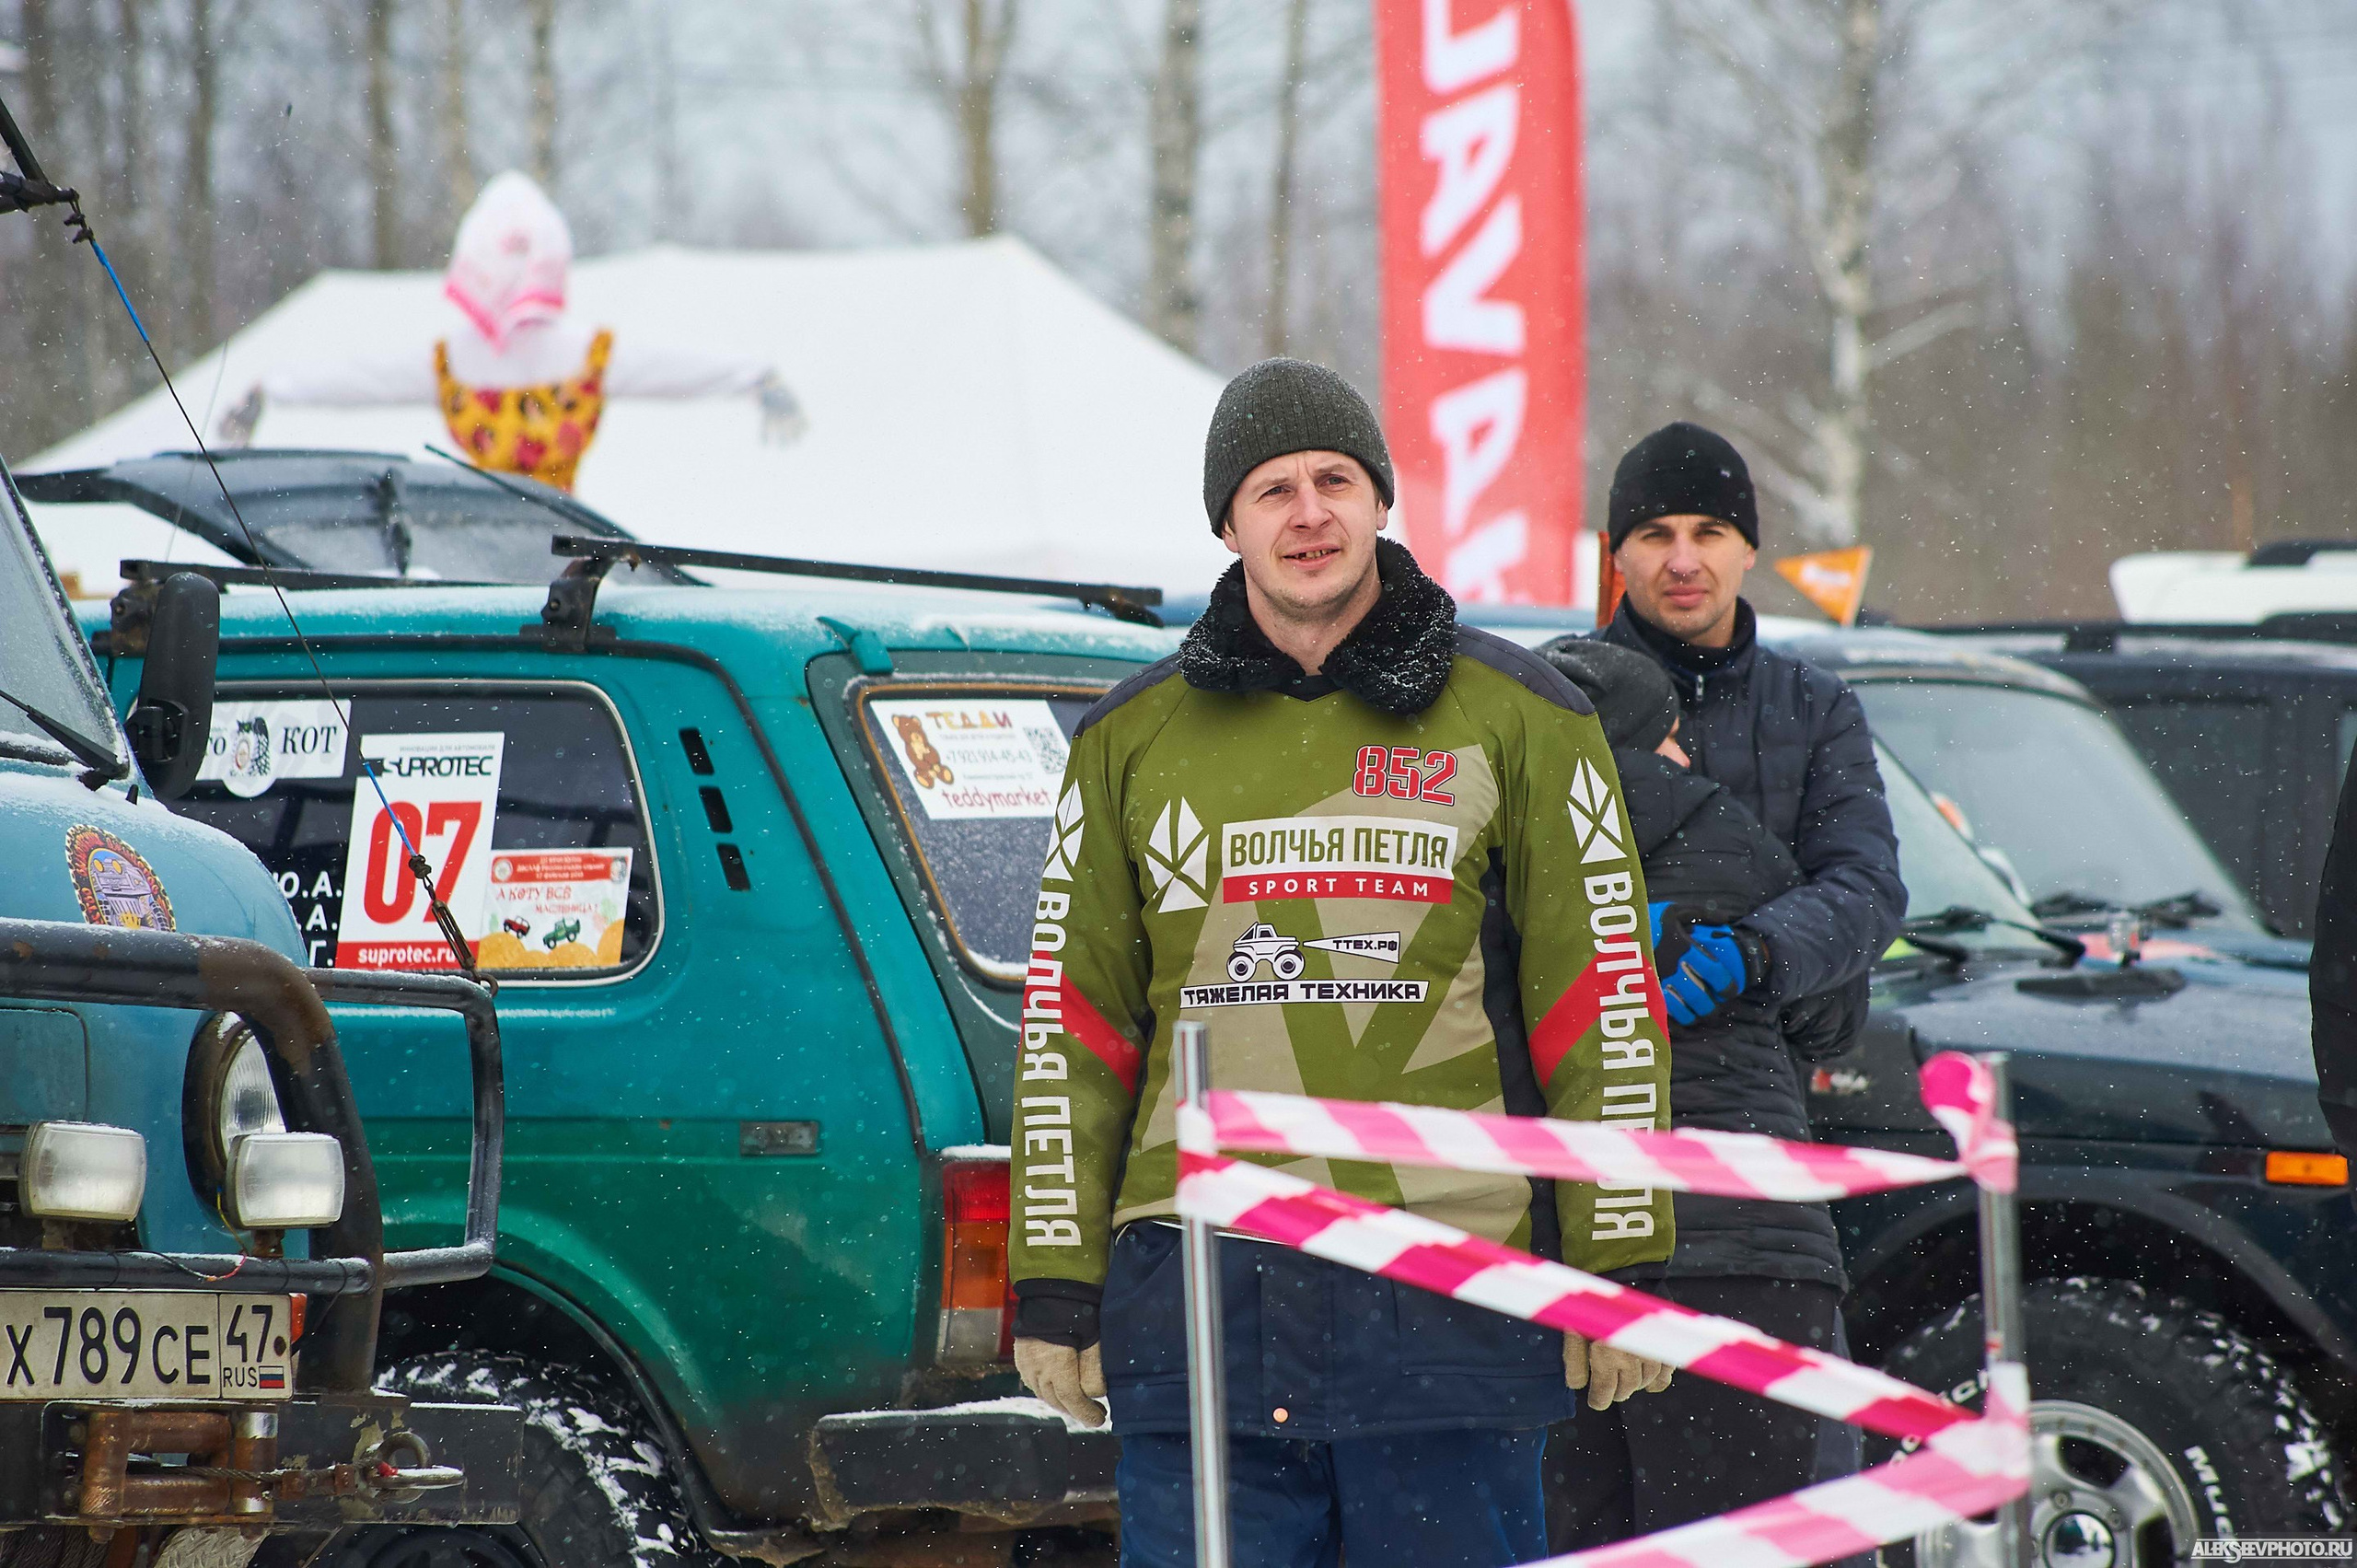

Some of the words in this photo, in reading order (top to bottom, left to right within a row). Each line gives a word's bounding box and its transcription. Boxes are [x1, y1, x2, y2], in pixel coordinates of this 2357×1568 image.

[282, 726, 337, 754] КОТ
[367, 755, 493, 777] SUPROTEC
[1353, 744, 1458, 807] 852
[941, 785, 1051, 812] teddymarket
[364, 801, 482, 924] 07
[1230, 828, 1344, 868] ВОЛЧЬЯ
[1353, 828, 1448, 870] ПЕТЛЯ
[1248, 878, 1336, 896] SPORT
[1355, 878, 1428, 897] TEAM
[358, 947, 458, 966] suprotec.ru
[1333, 939, 1398, 951] ТТЕХ.РФ
[1022, 890, 1071, 1081] ВОЛЧЬЯ
[1584, 871, 1655, 1070] ВОЛЧЬЯ
[1184, 985, 1289, 1005] ТЯЖЕЛАЯ
[1300, 982, 1421, 1000] ТЕХНИКА
[1021, 1096, 1082, 1247] ПЕТЛЯ
[1592, 1082, 1657, 1241] ПЛЯ
[226, 1304, 273, 1363] 47
[223, 1366, 258, 1388] RUS
